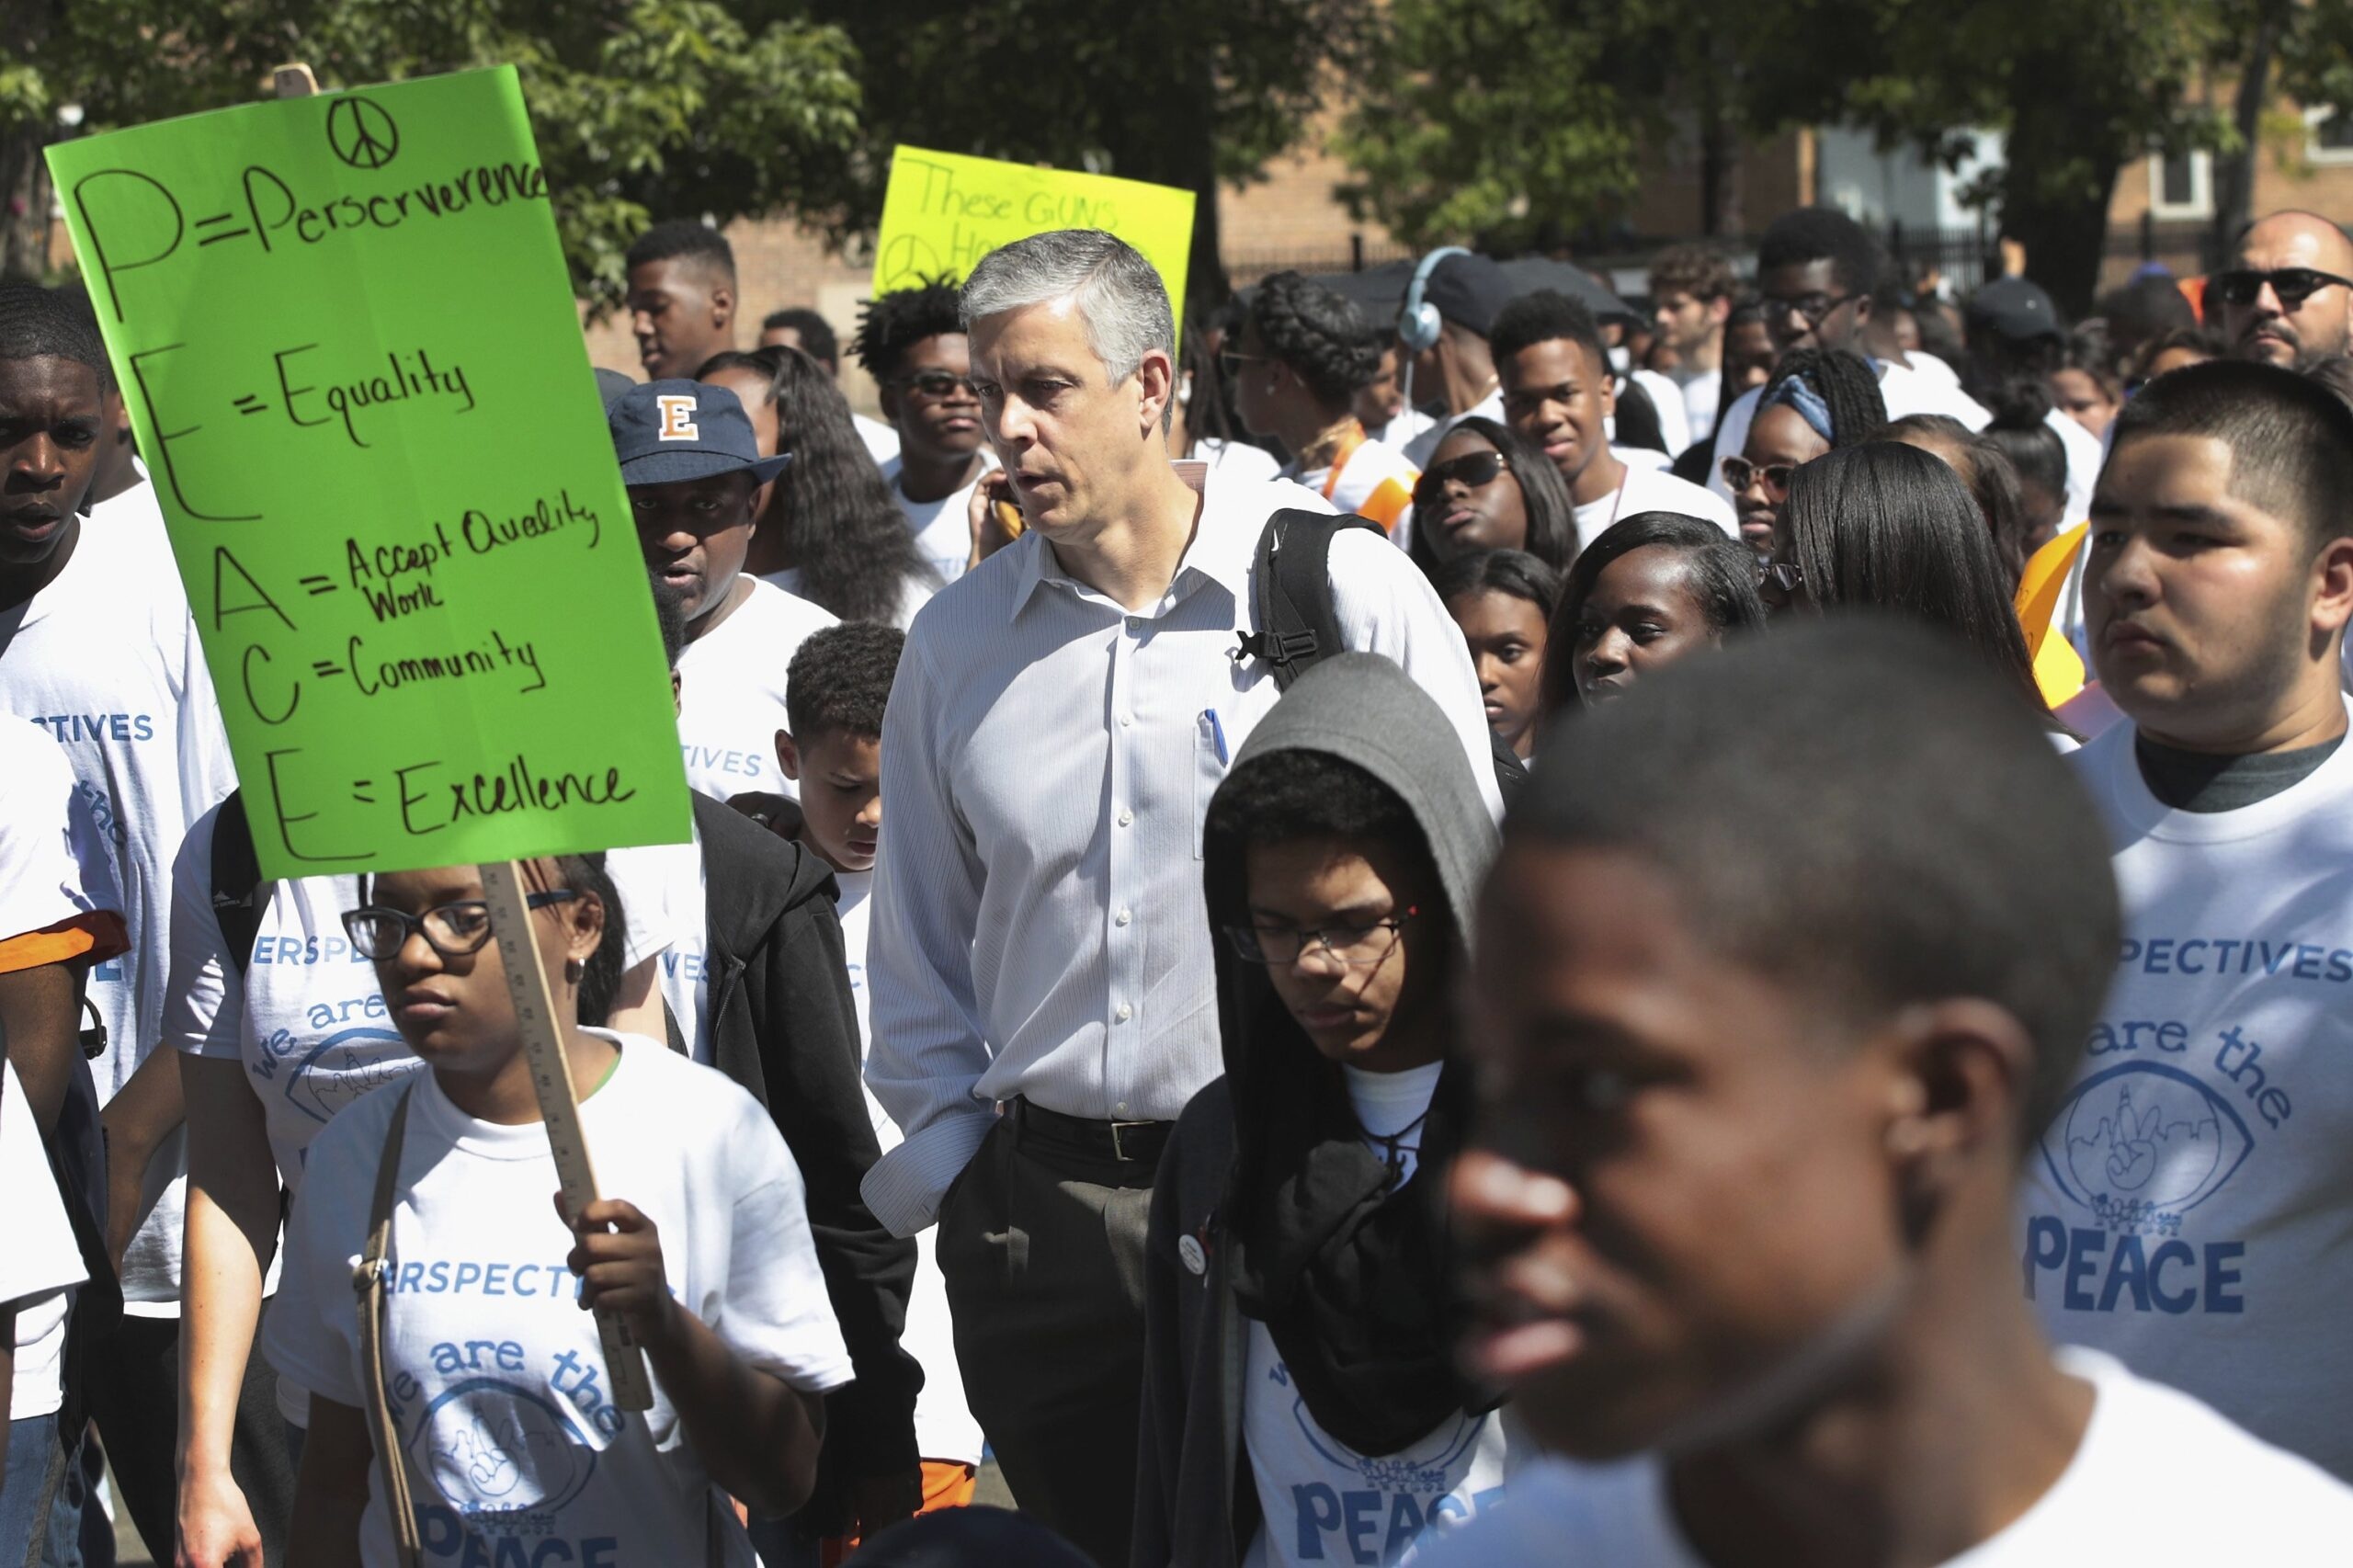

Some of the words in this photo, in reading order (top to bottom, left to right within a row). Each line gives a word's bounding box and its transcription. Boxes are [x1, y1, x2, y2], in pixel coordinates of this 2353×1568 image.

[900, 157, 1012, 221] These
[1023, 190, 1119, 232] GUNS
[74, 168, 184, 324] P
[130, 342, 264, 521] E
[274, 342, 475, 449] Equality
[656, 395, 699, 441] E
[214, 545, 299, 632] A
[346, 521, 454, 589] Accept
[462, 488, 600, 554] Quality
[361, 579, 444, 622] Work
[242, 643, 300, 725] C
[348, 630, 547, 697] Community
[264, 747, 378, 862] E
[393, 754, 637, 835] Excellence
[252, 1028, 299, 1081] we
[306, 993, 388, 1030] are
[2085, 1019, 2188, 1058] are
[2212, 1025, 2292, 1131] the
[2023, 1215, 2245, 1314] PEACE
[429, 1339, 526, 1375] are
[550, 1348, 626, 1442] the
